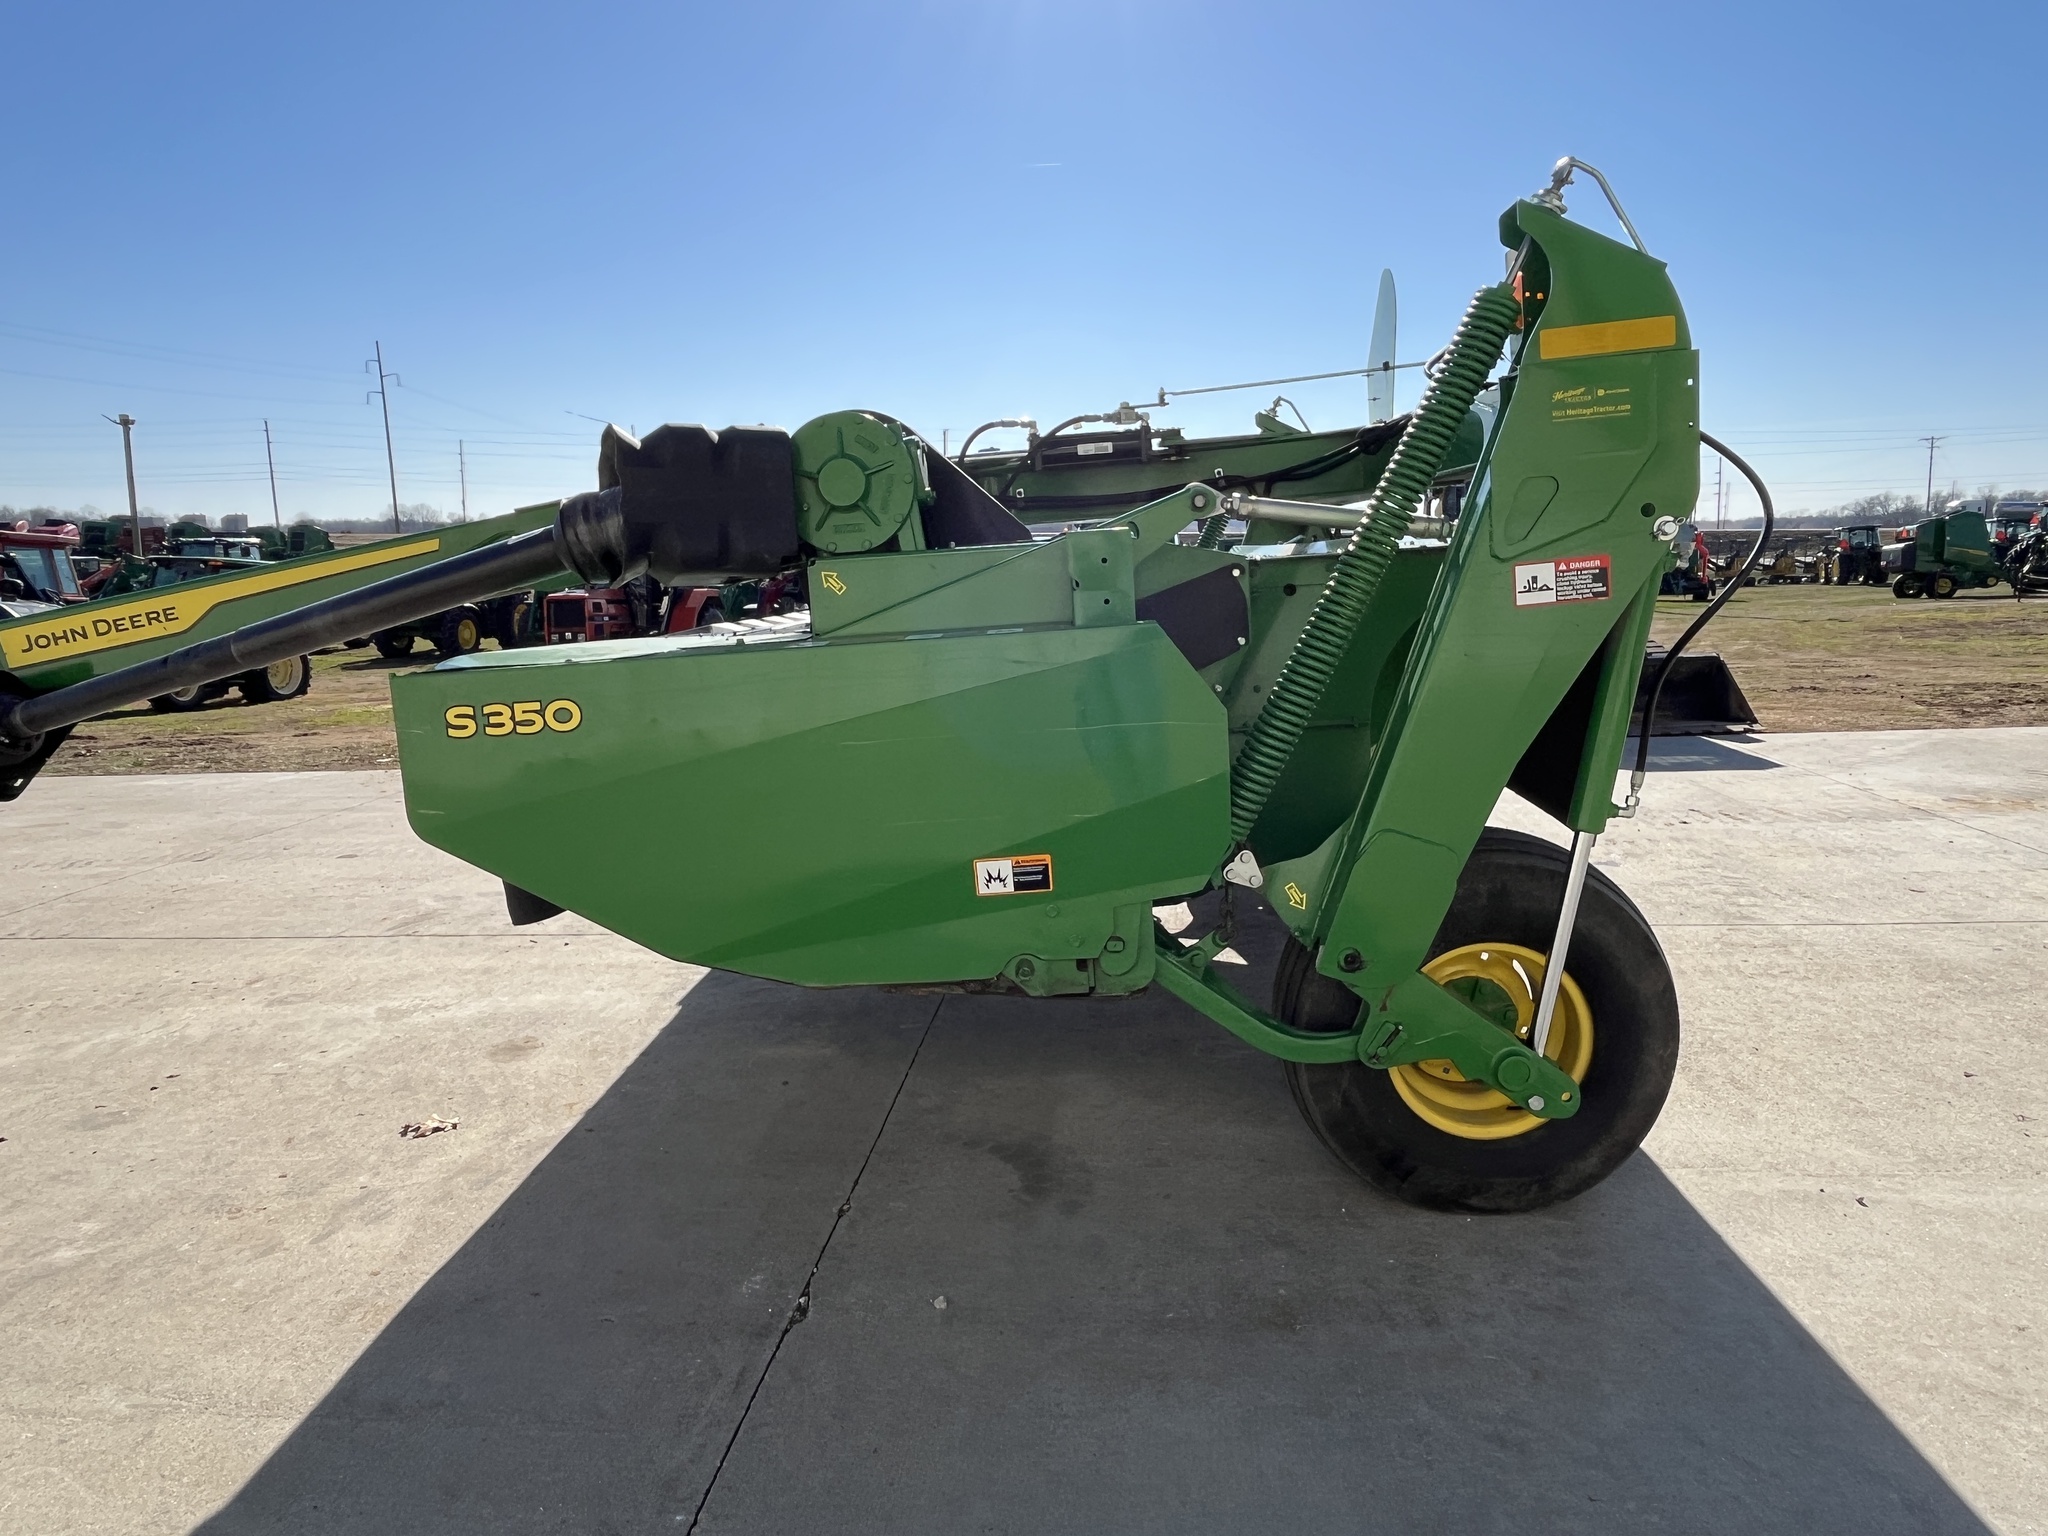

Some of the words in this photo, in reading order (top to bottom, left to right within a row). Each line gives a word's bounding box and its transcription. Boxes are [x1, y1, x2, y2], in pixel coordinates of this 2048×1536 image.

[1569, 560, 1600, 569] DANGER
[21, 625, 89, 653] JOHN
[92, 606, 179, 637] DEERE
[444, 704, 478, 739] S
[482, 698, 583, 737] 350
